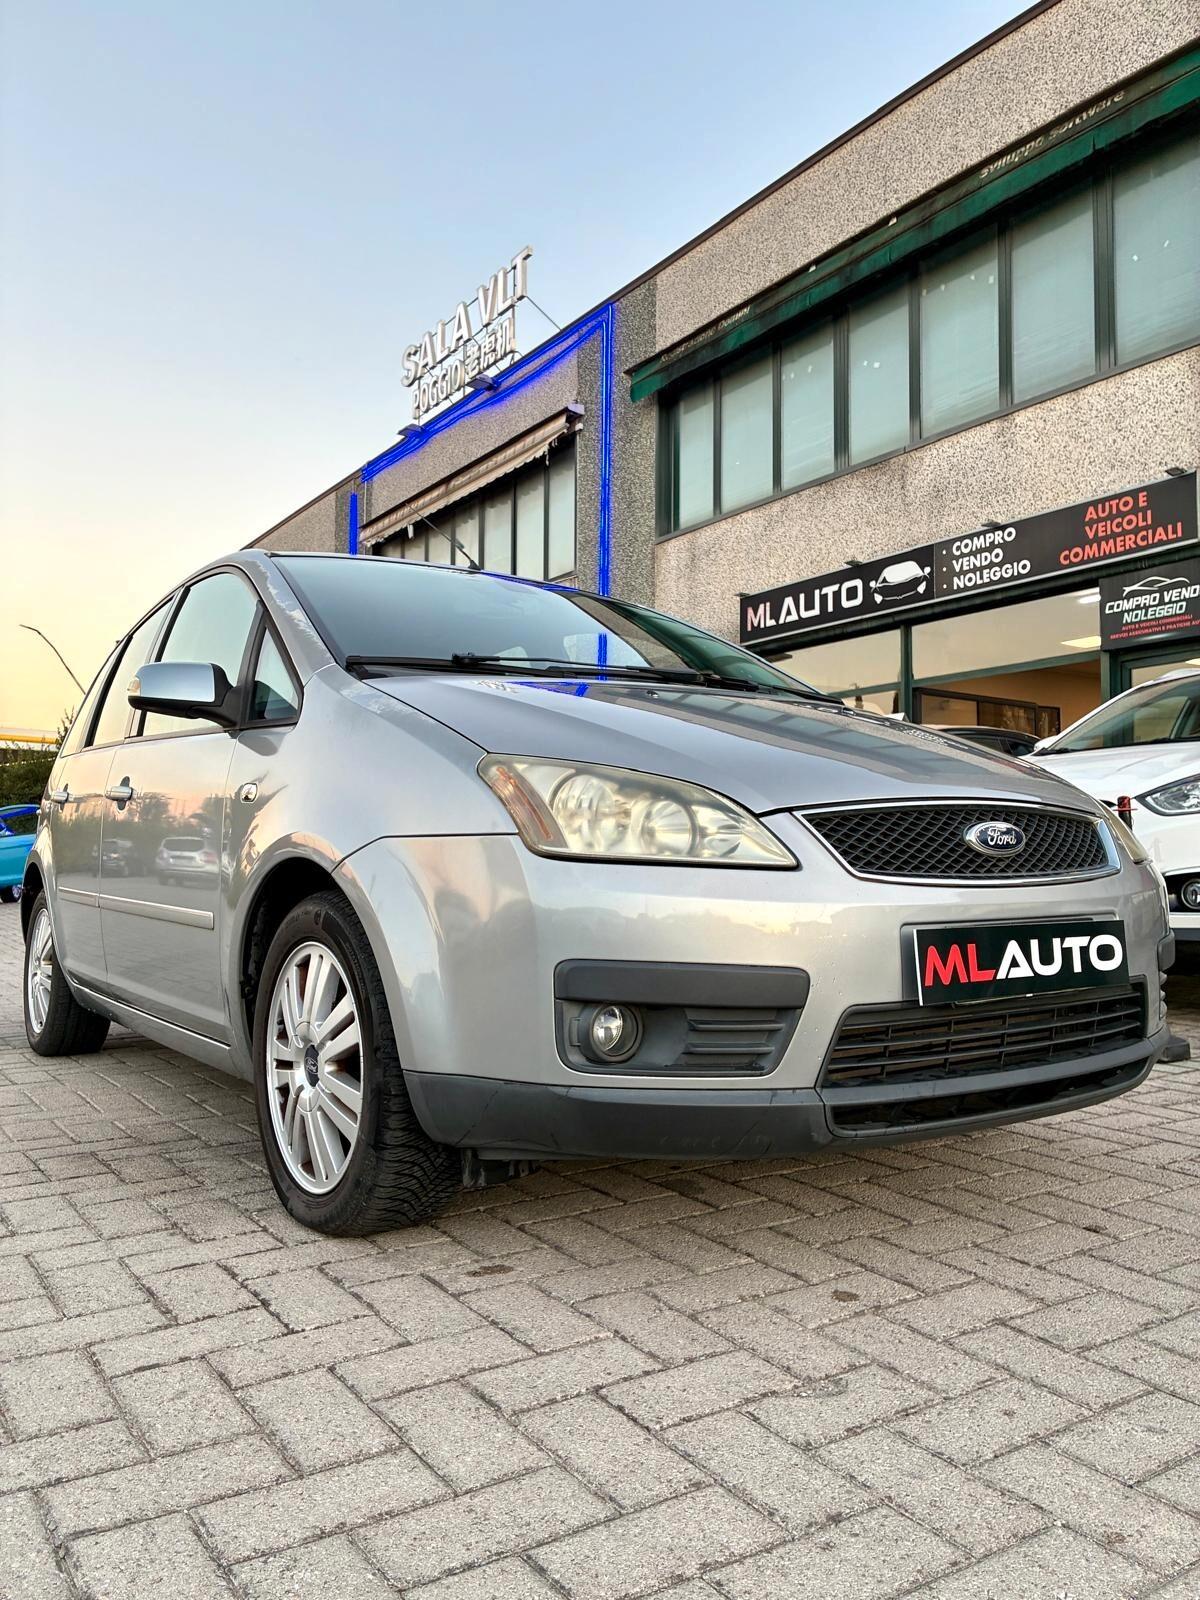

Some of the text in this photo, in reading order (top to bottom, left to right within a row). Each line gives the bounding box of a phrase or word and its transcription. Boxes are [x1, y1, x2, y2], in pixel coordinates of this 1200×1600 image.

[401, 245, 533, 387] SALA VLT
[412, 359, 465, 419] POGGIO
[1084, 491, 1148, 522] AUTO E
[1084, 510, 1152, 540] VEICOLI
[952, 526, 1017, 556] COMPRO
[1059, 521, 1183, 566] COMMERCIALI
[952, 548, 1004, 573] VENDO
[953, 559, 1031, 590] NOLEGGIO
[1105, 592, 1160, 614] COMPRO
[1122, 601, 1187, 624] NOLEGGIO
[987, 827, 1017, 846] Ford
